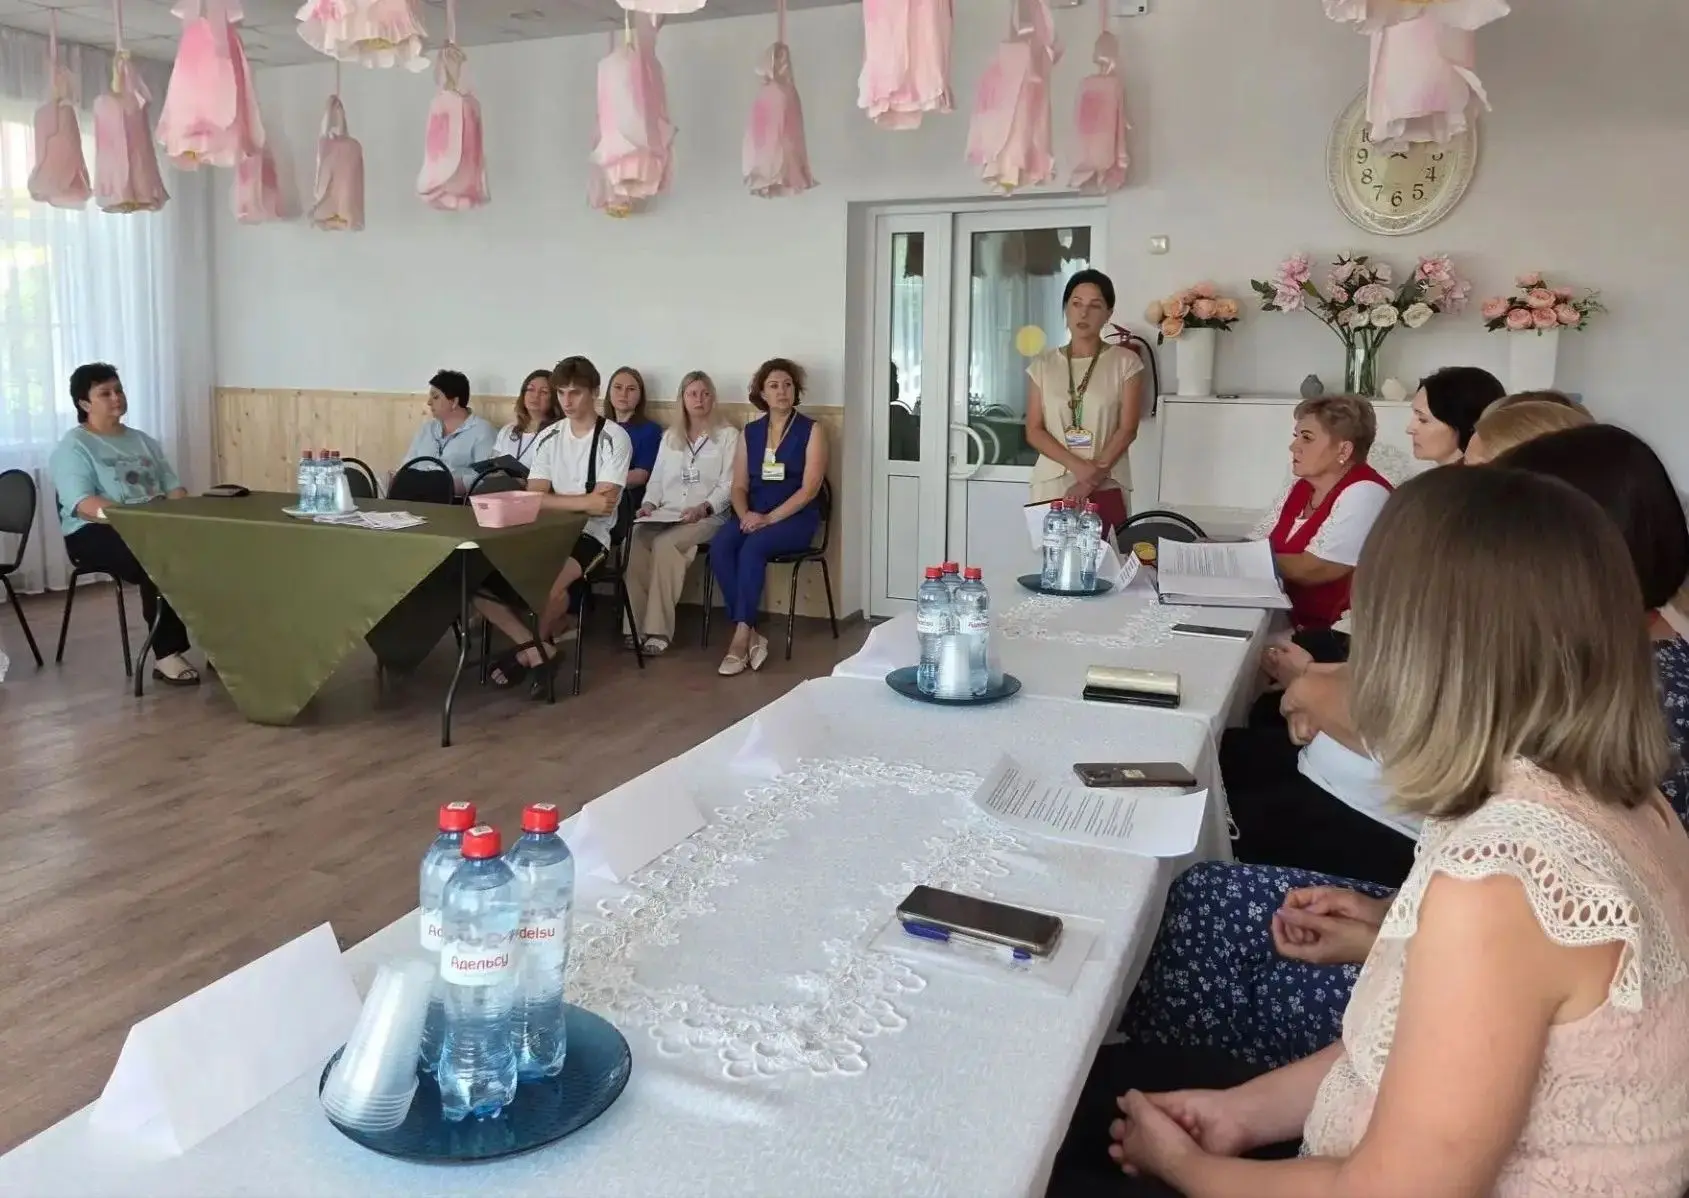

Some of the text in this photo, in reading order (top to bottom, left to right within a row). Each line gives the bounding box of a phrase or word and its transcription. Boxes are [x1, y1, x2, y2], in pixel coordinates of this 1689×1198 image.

[1357, 148, 1368, 164] 9
[1361, 168, 1373, 185] 8
[1425, 166, 1437, 182] 4
[1373, 185, 1384, 202] 7
[1391, 191, 1402, 207] 6
[1412, 184, 1424, 200] 5
[451, 953, 509, 970] Адельсу
